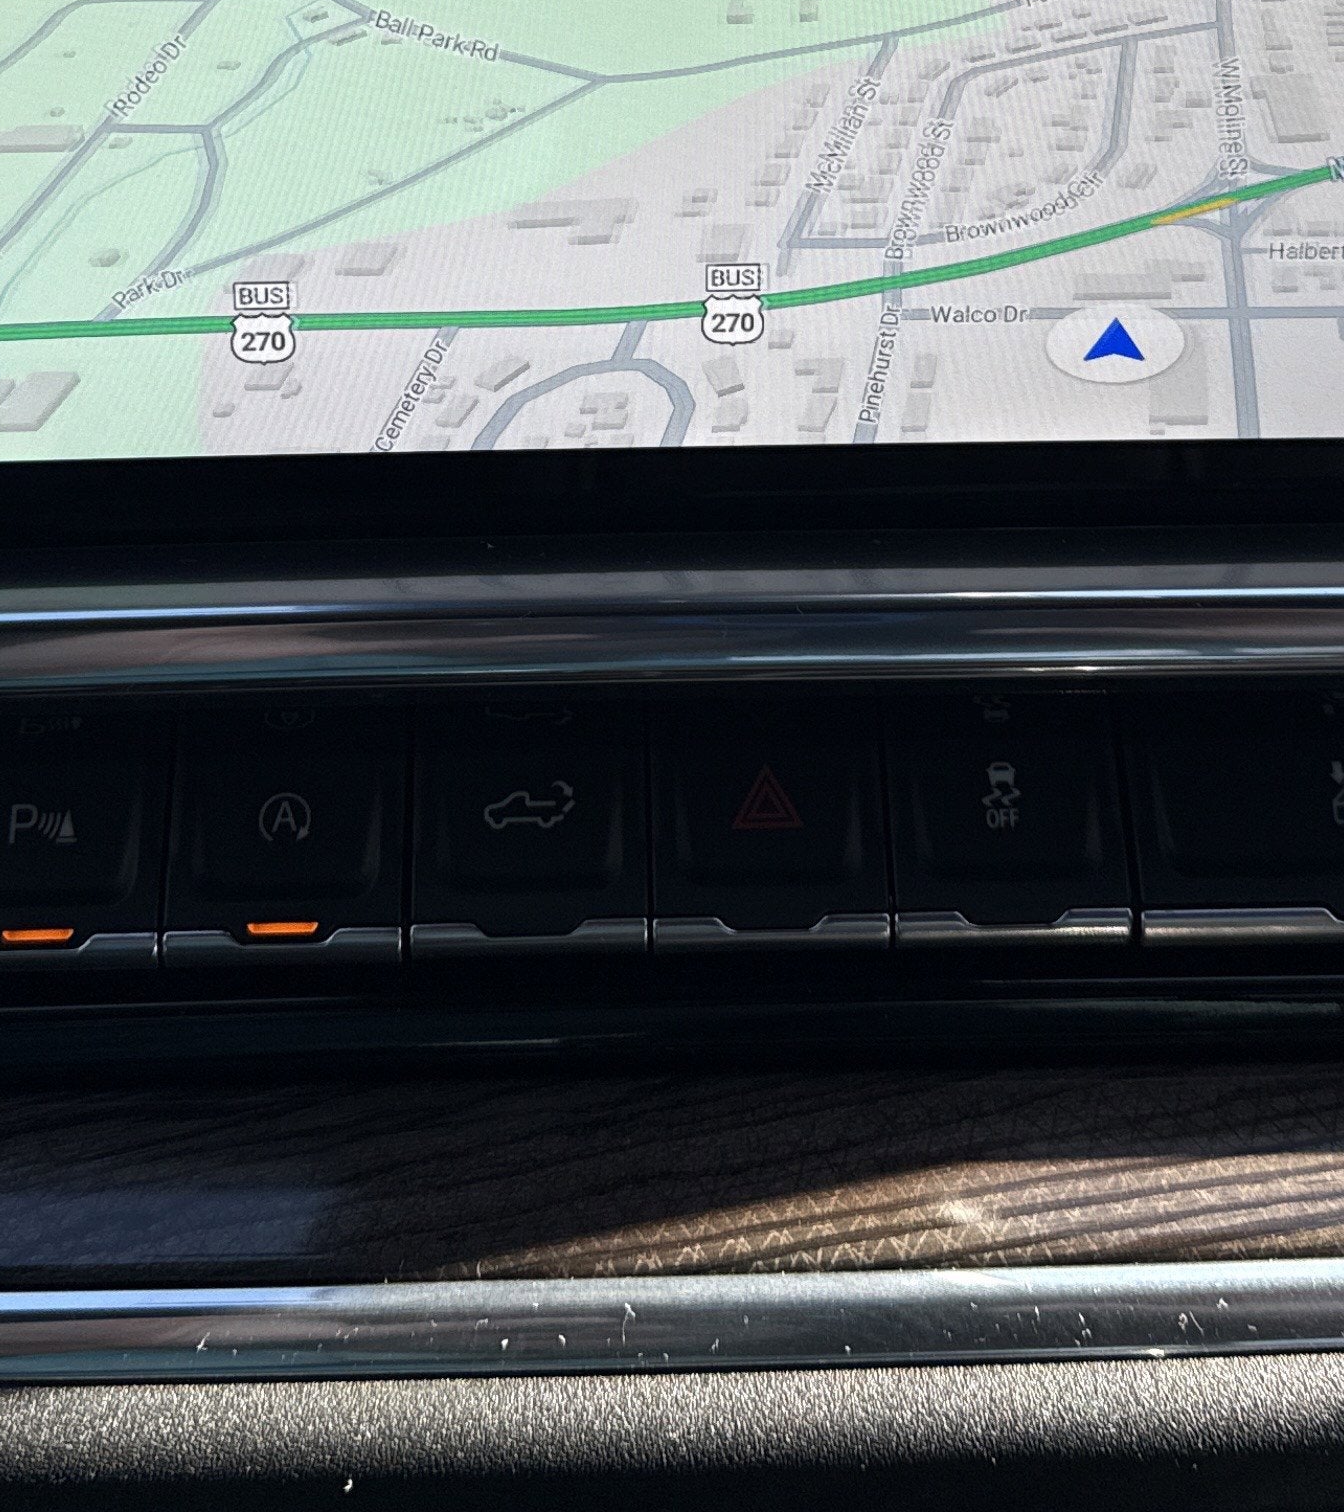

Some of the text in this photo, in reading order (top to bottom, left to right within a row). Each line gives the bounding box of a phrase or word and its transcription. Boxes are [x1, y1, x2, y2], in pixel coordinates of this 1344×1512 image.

[374, 8, 500, 64] Ball Park Rd
[111, 33, 188, 118] Rodeo Dr
[805, 75, 882, 193] McMillan St
[884, 146, 946, 262] Brownwood
[944, 195, 1078, 244] Brownwood
[111, 267, 188, 312] Park Dr
[237, 285, 285, 307] BUS
[710, 267, 756, 288] BUS
[711, 311, 757, 335] 270
[931, 303, 1030, 324] Walco Dr
[239, 331, 287, 353] 270
[858, 303, 903, 424] Pinehurst Dr
[374, 338, 451, 454] Cemetery Dr
[986, 808, 1020, 830] OFF
